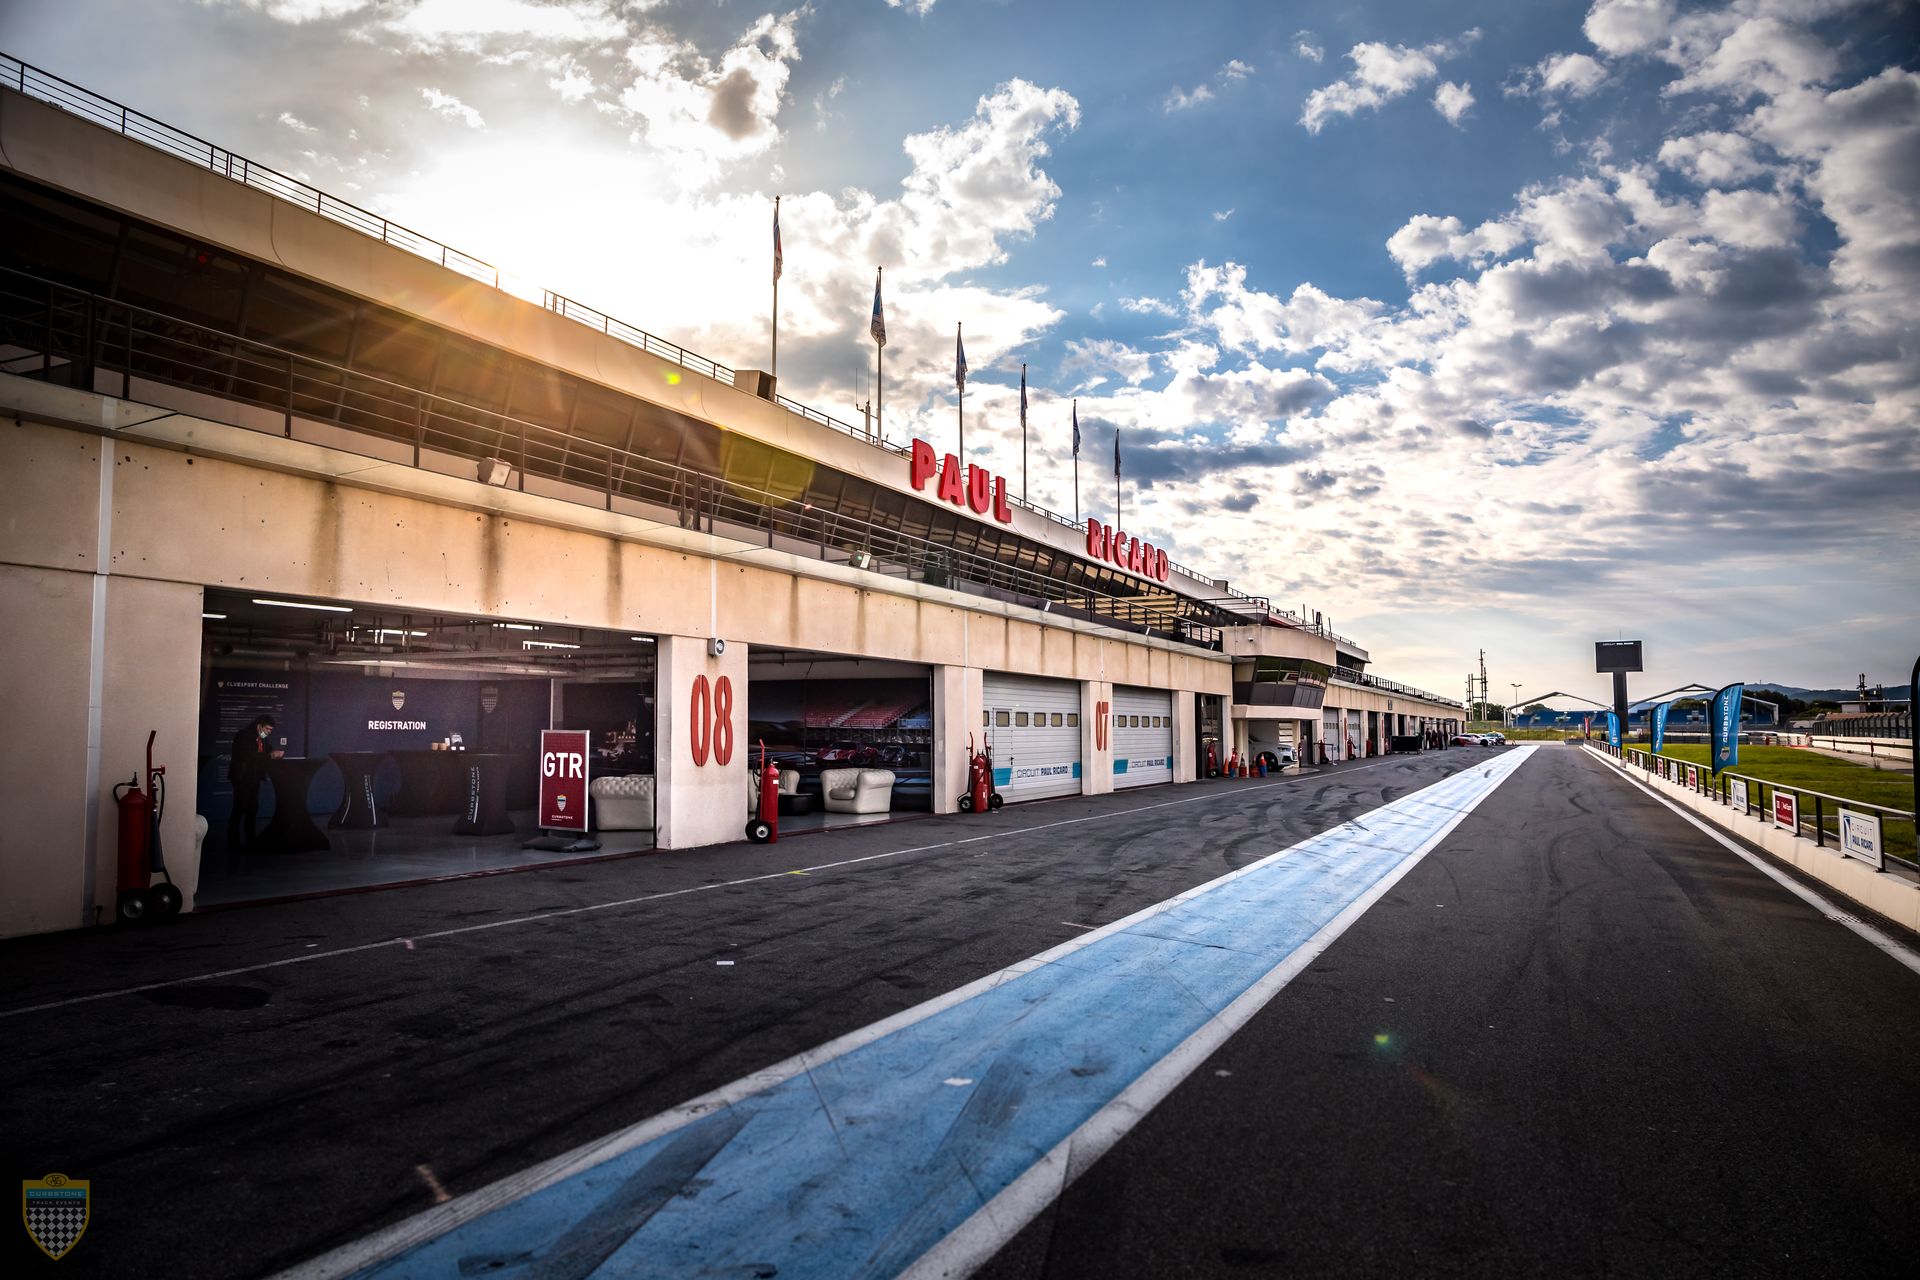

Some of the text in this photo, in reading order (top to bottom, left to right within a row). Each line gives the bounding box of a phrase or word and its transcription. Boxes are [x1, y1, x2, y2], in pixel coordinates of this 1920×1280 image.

[911, 438, 1169, 582] PAUL RICARD
[368, 720, 427, 731] REGISTRATION
[690, 674, 734, 767] 08
[1095, 700, 1109, 752] 07
[543, 751, 583, 779] GTR
[1016, 765, 1068, 778] CIRCUIT PAUL RICARD
[1131, 760, 1147, 768] CIRCUIT
[1154, 758, 1165, 766] RICARD
[467, 766, 476, 820] CURBSTONE
[1852, 835, 1873, 852] PAUL RICARD
